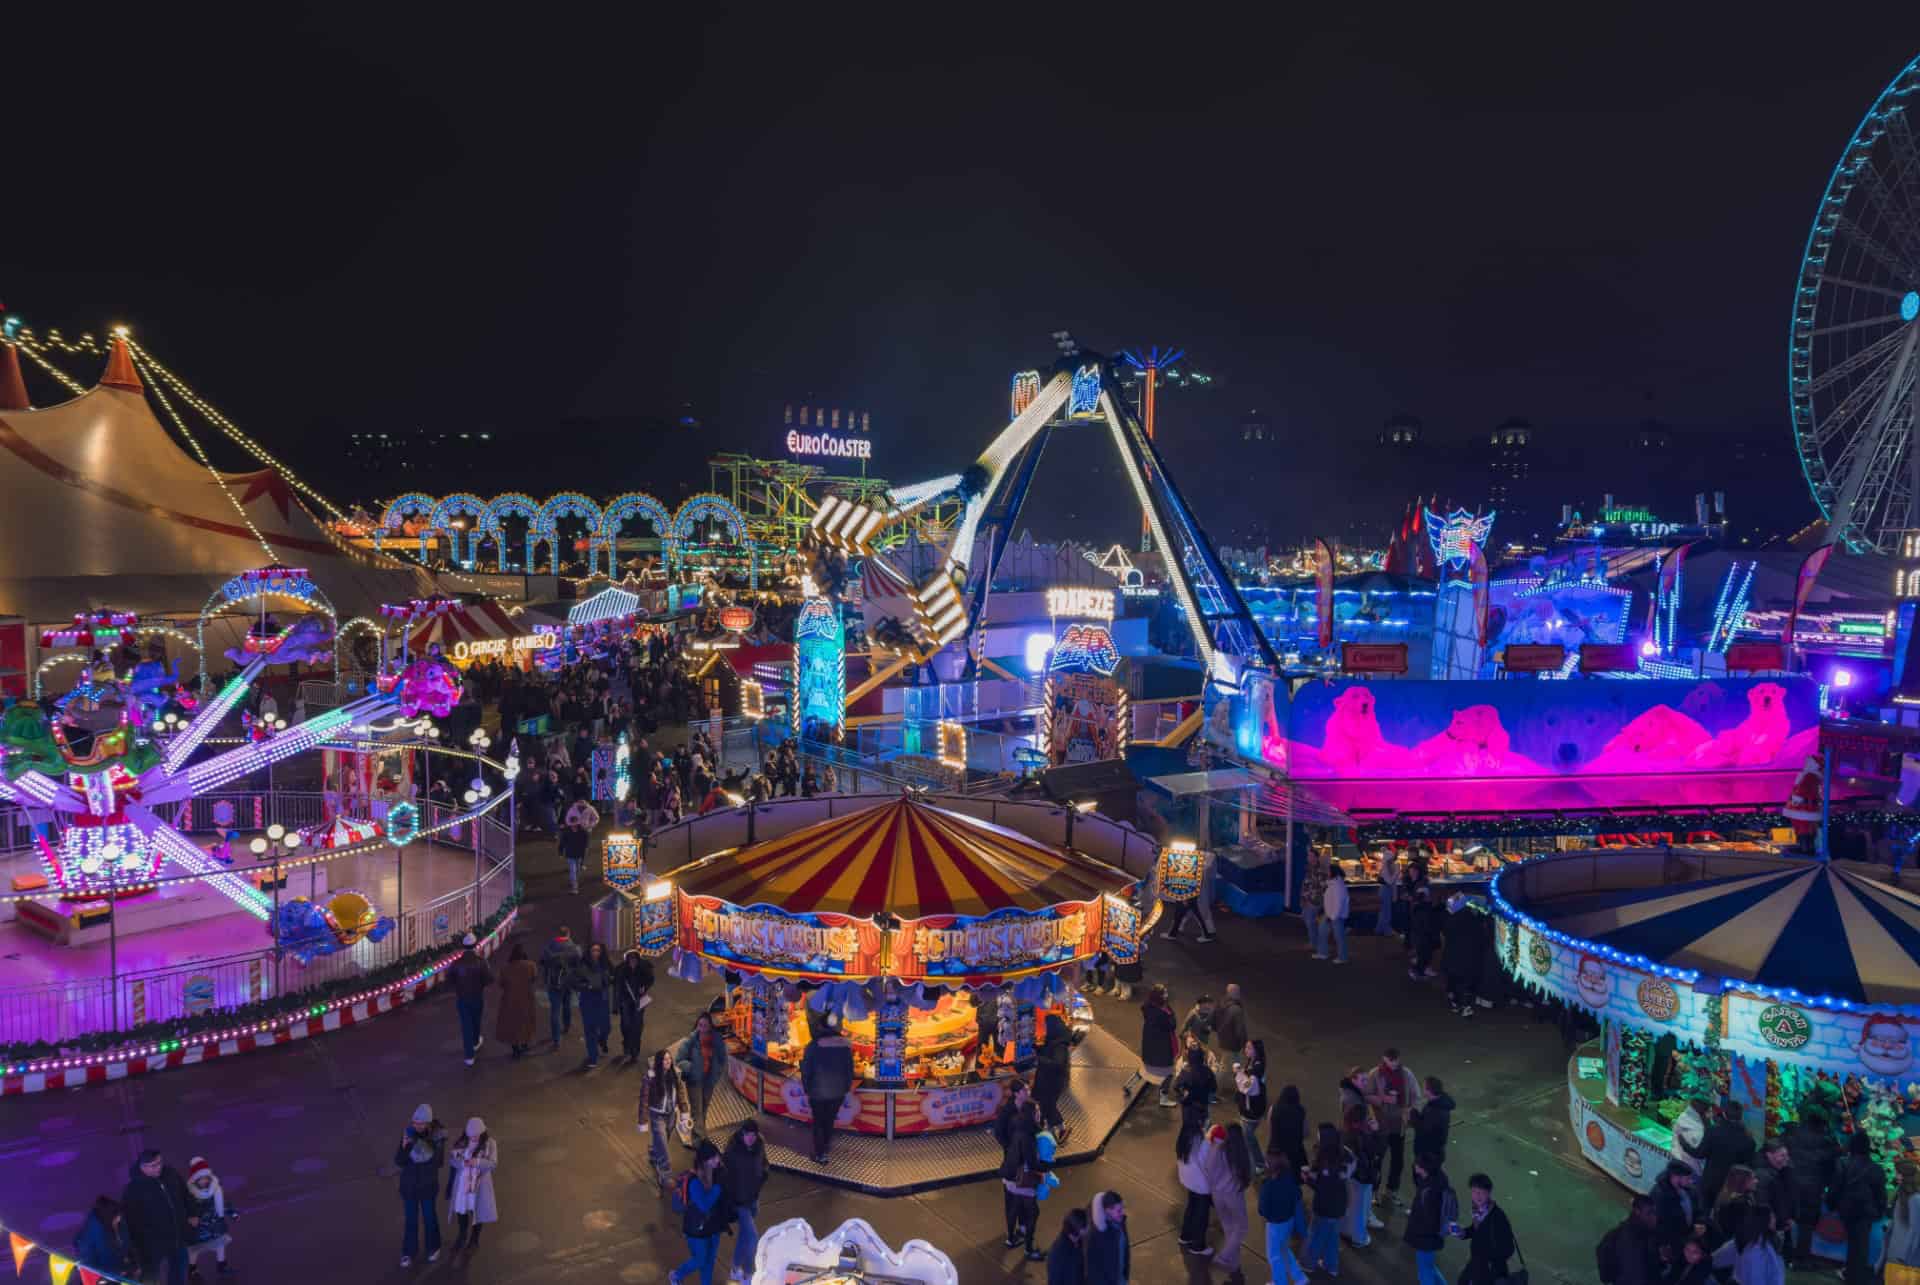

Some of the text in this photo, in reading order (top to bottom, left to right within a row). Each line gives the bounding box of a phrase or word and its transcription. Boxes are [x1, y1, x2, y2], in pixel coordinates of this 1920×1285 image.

[470, 634, 545, 656] CIRCUS GAMES
[702, 908, 765, 951] CIRCUS
[767, 918, 848, 959] CIRCUS
[927, 921, 1008, 962] CIRCUS
[1008, 912, 1082, 953] CIRCUS
[1762, 1007, 1807, 1029] CATCH
[1776, 1018, 1793, 1033] A
[1761, 1027, 1807, 1047] SANTA
